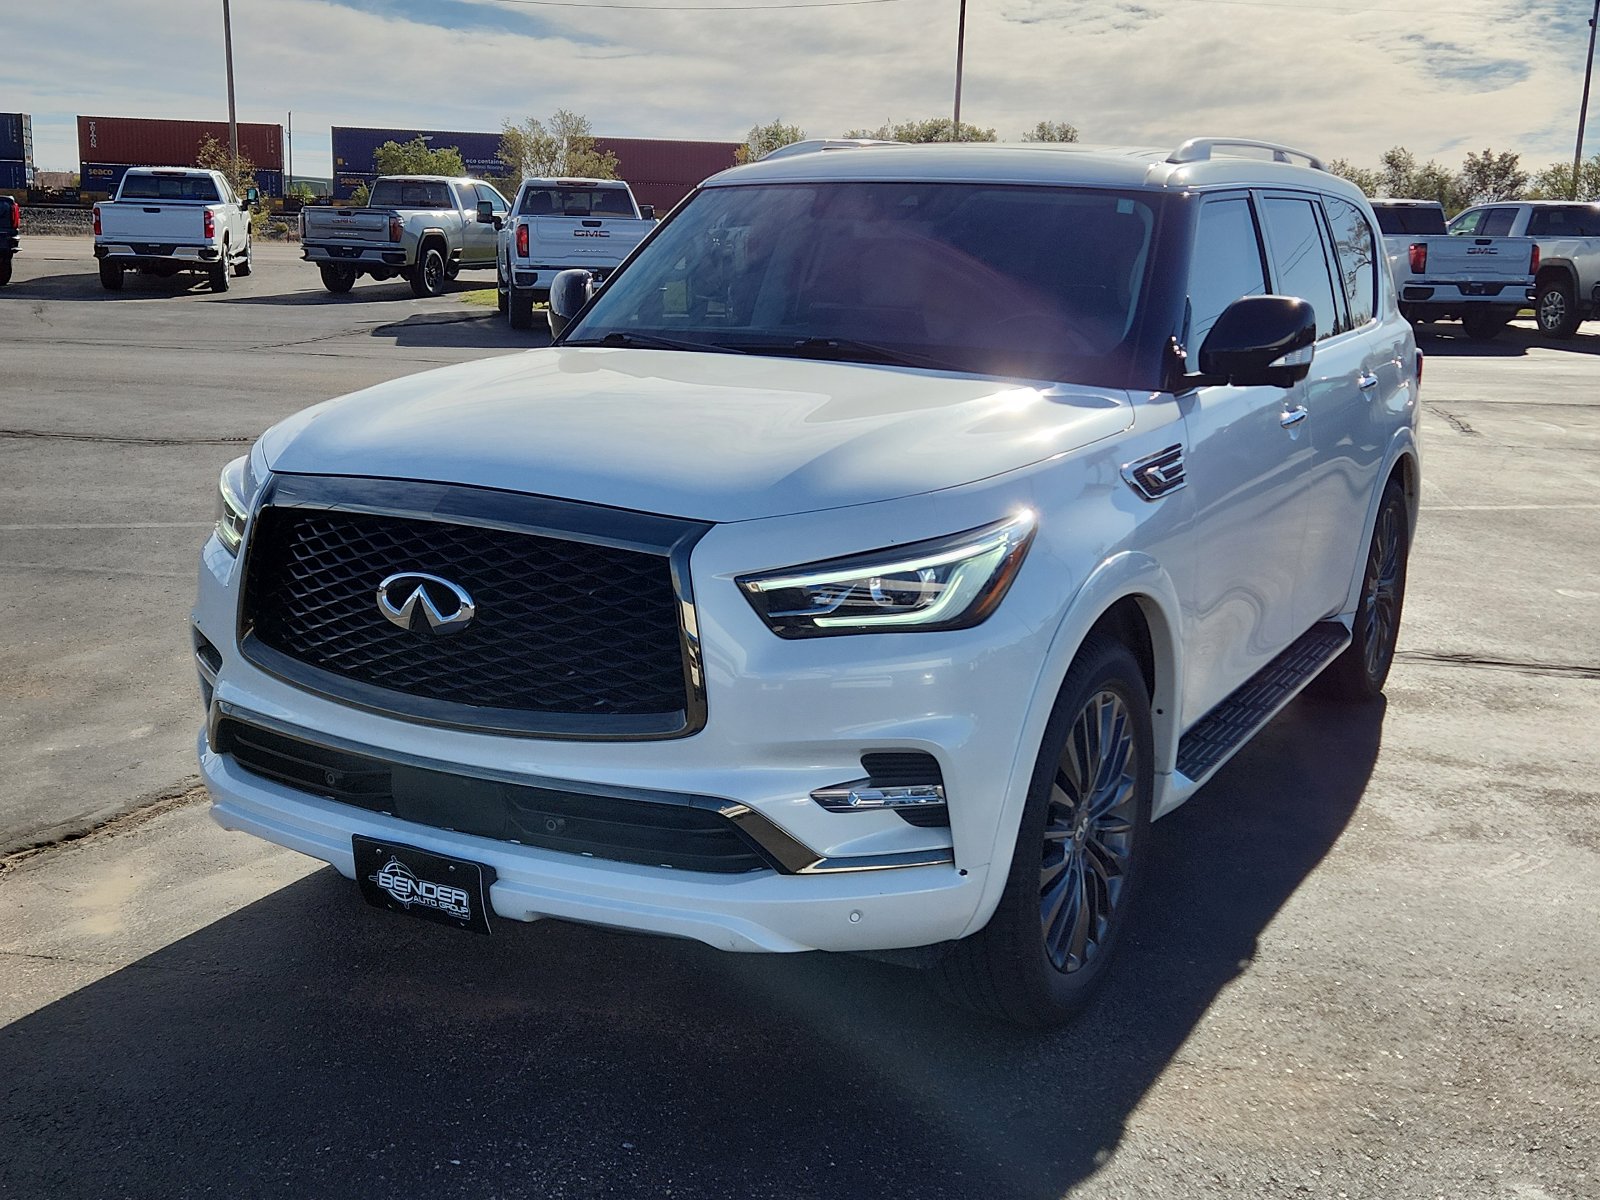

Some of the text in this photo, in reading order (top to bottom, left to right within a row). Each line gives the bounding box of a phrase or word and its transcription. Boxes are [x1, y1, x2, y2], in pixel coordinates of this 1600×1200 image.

[88, 168, 113, 176] seaco
[574, 230, 610, 238] GMC
[1467, 247, 1498, 255] GMC
[378, 872, 467, 907] BENDER
[413, 895, 437, 907] AUTO
[438, 901, 469, 914] GROUP
